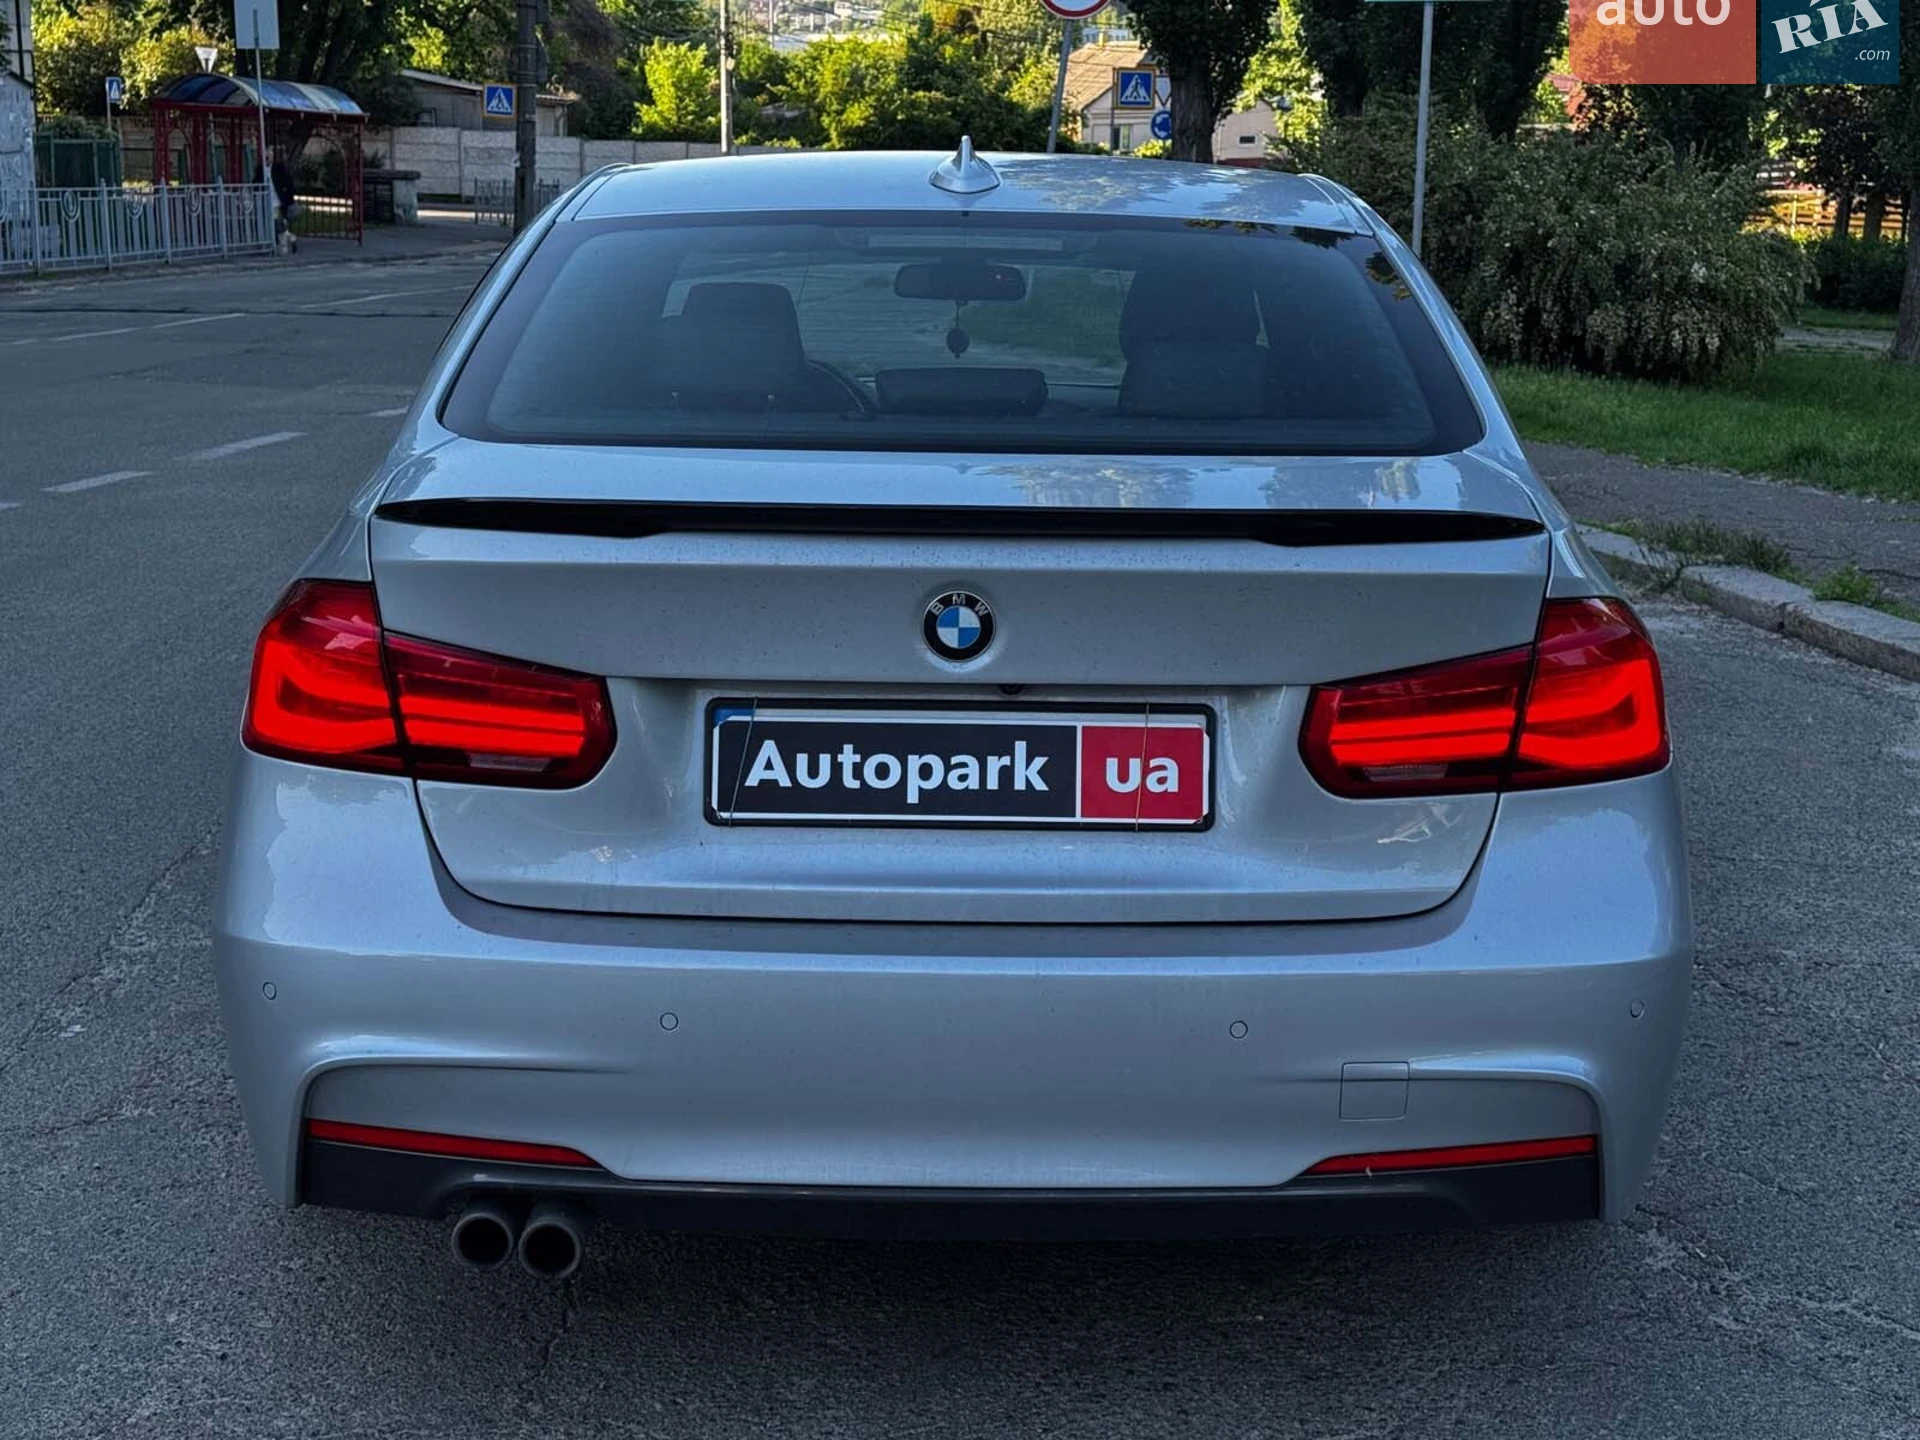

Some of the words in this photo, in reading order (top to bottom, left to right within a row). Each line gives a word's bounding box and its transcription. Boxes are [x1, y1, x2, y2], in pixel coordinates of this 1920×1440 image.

[929, 593, 990, 617] BMW
[744, 739, 1049, 804] Autopark
[1105, 756, 1179, 793] ua
